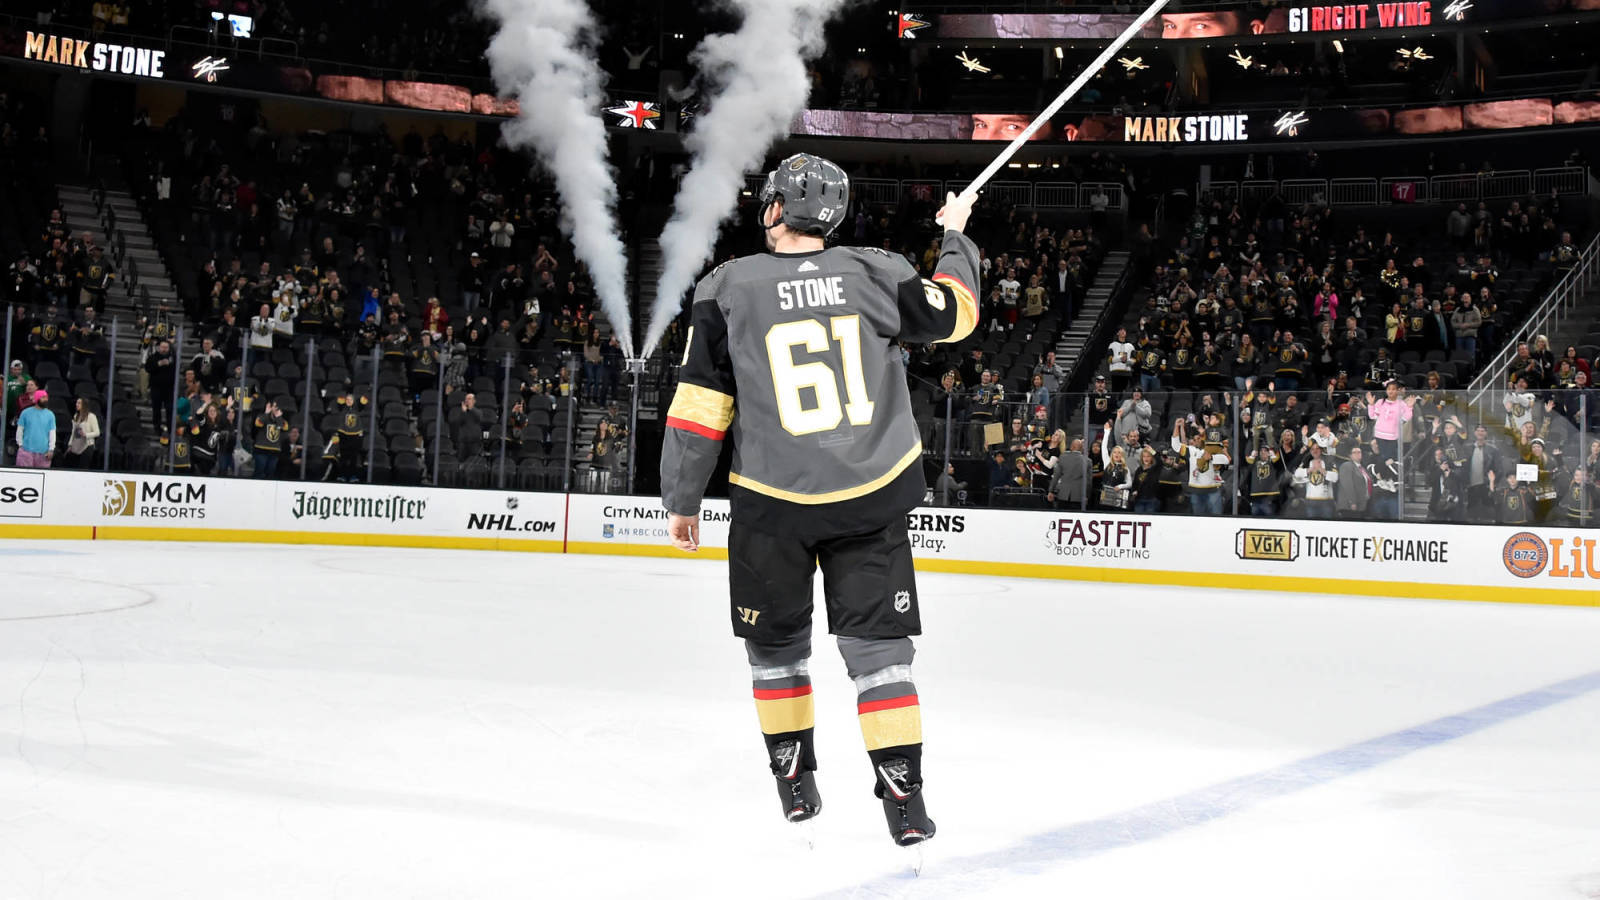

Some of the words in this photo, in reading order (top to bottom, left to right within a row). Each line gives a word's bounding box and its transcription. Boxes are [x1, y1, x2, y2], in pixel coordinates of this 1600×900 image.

[1289, 8, 1308, 32] 61
[1311, 6, 1369, 31] RIGHT
[1378, 1, 1432, 28] WING
[24, 31, 91, 68] MARK
[93, 43, 165, 78] STONE
[1124, 117, 1182, 142] MARK
[1184, 114, 1248, 142] STONE
[1396, 184, 1410, 199] 17
[817, 207, 835, 222] 61
[777, 276, 846, 310] STONE
[764, 314, 875, 437] 61
[0, 486, 39, 504] se
[141, 481, 206, 504] MGM
[140, 505, 206, 519] RESORTS
[703, 509, 732, 522] BAN
[618, 527, 630, 536] AN
[633, 528, 649, 537] RBC
[906, 514, 965, 533] ERNS
[911, 533, 946, 553] Play.
[1056, 546, 1086, 556] BODY
[1091, 547, 1150, 559] SCULPTING
[1251, 535, 1285, 553] VGK
[1305, 536, 1359, 559] TICKET
[1362, 536, 1448, 563] EXCHANGE
[1513, 550, 1538, 561] 872
[1548, 536, 1600, 579] LiU
